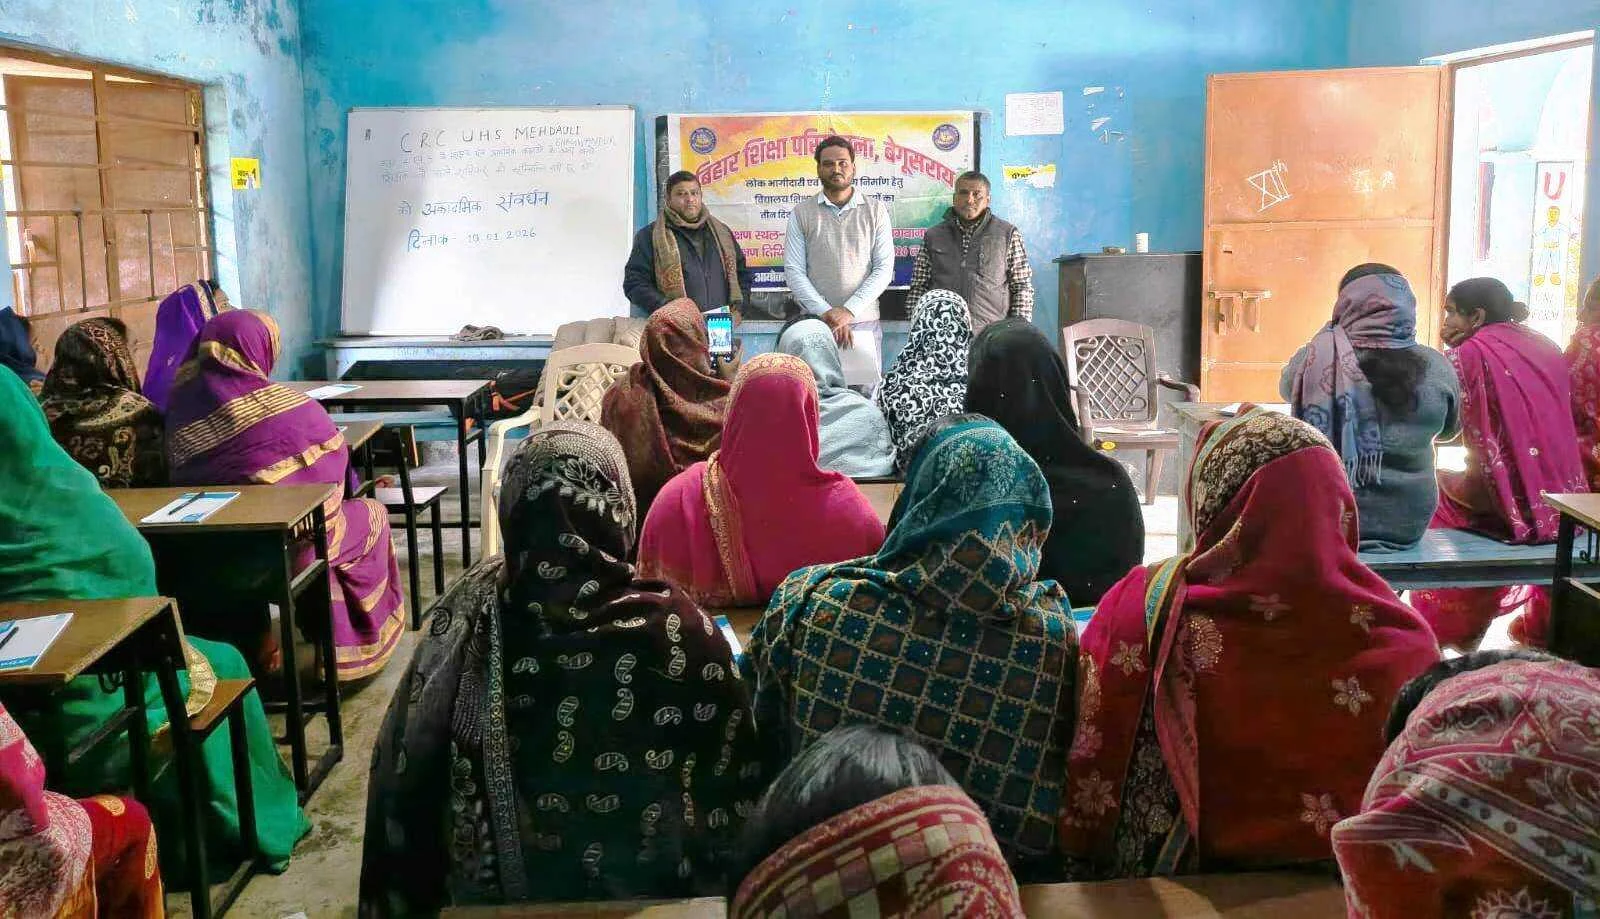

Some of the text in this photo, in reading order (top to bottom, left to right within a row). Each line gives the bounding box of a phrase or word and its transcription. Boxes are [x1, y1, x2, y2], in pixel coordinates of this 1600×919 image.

[462, 127, 503, 142] UHS
[695, 150, 741, 186] बिहार
[744, 137, 787, 168] शिक्षा
[883, 135, 957, 188] बेगूसराय
[745, 177, 766, 188] लोक
[768, 177, 805, 188] भागीदारी
[860, 176, 890, 187] निर्माण
[754, 193, 788, 204] विद्यालय
